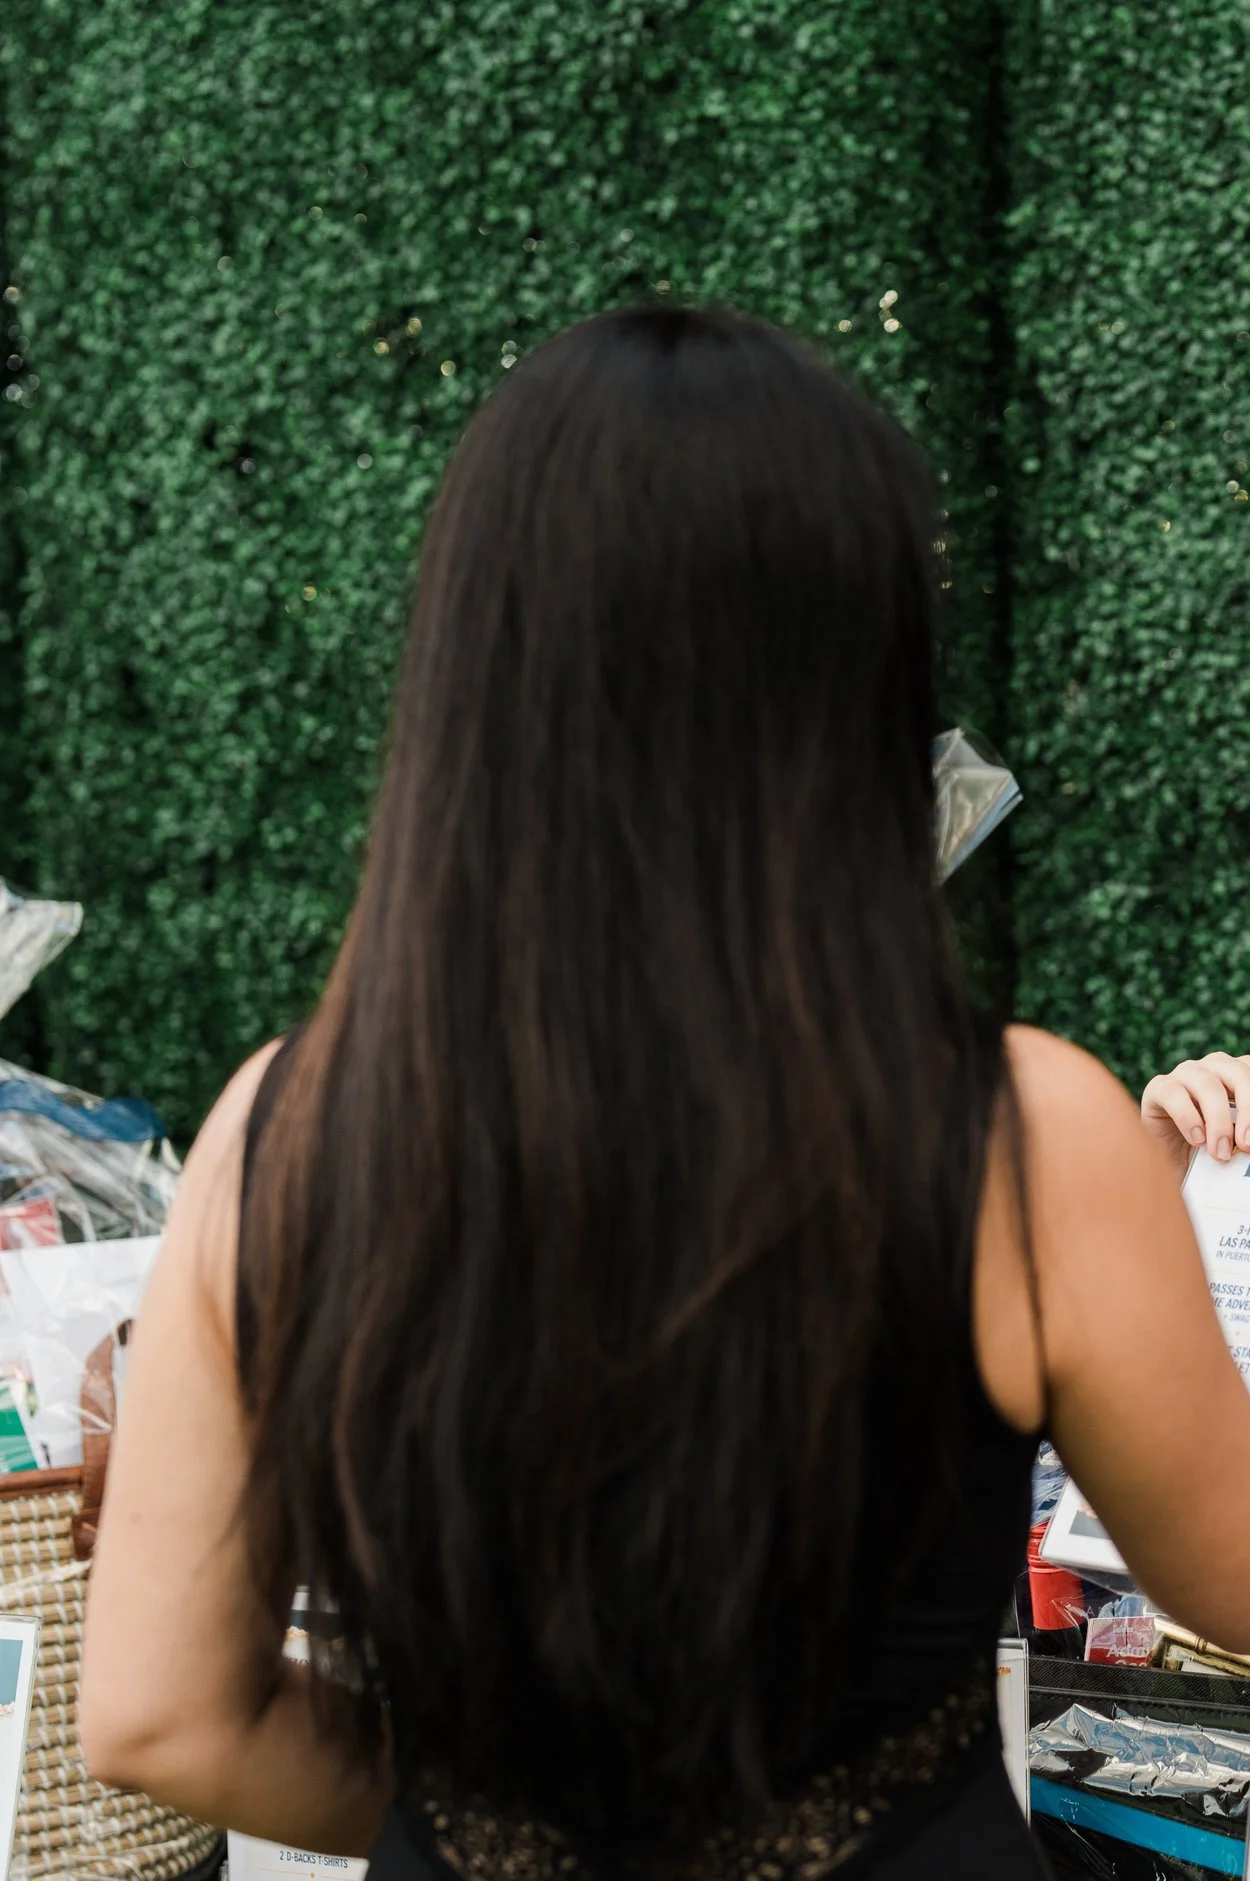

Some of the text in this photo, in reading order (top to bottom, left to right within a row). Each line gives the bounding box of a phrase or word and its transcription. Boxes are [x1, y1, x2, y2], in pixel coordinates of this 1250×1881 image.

[1219, 1236, 1238, 1248] LAS
[1216, 1250, 1225, 1259] IN
[1209, 1282, 1244, 1295] PASSES
[280, 1850, 349, 1869] 2 D-BACKS T-SHIRTS
